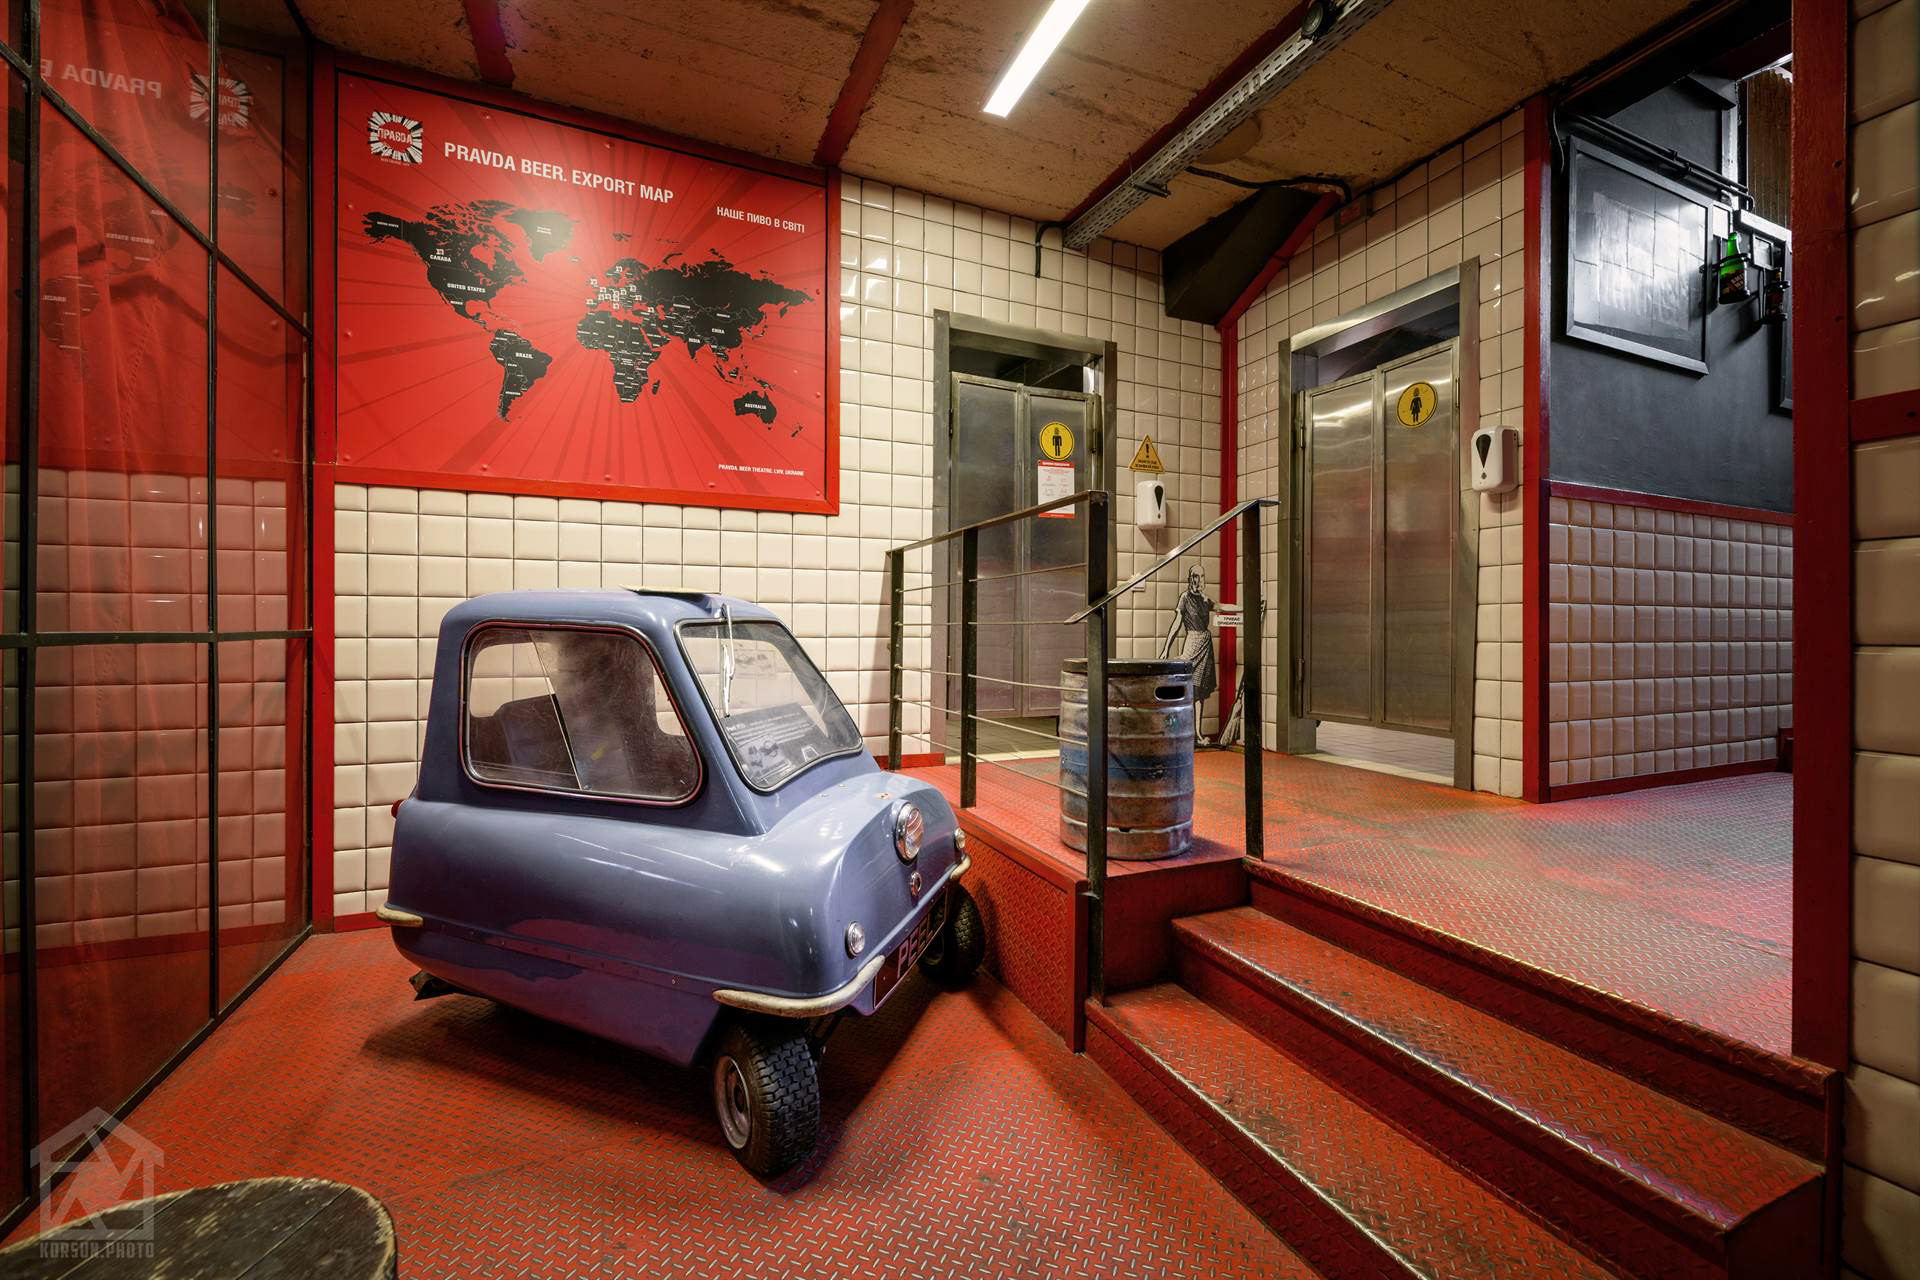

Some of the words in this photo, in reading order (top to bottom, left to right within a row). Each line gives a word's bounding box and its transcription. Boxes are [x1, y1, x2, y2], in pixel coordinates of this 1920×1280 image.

[444, 141, 516, 171] PRAVDA
[521, 158, 567, 182] BEER.
[572, 169, 635, 196] EXPORT
[639, 184, 673, 203] MAP
[716, 206, 744, 221] НАШЕ
[747, 212, 771, 226] ПИВО
[774, 218, 780, 228] В
[782, 220, 805, 233] СВІТІ
